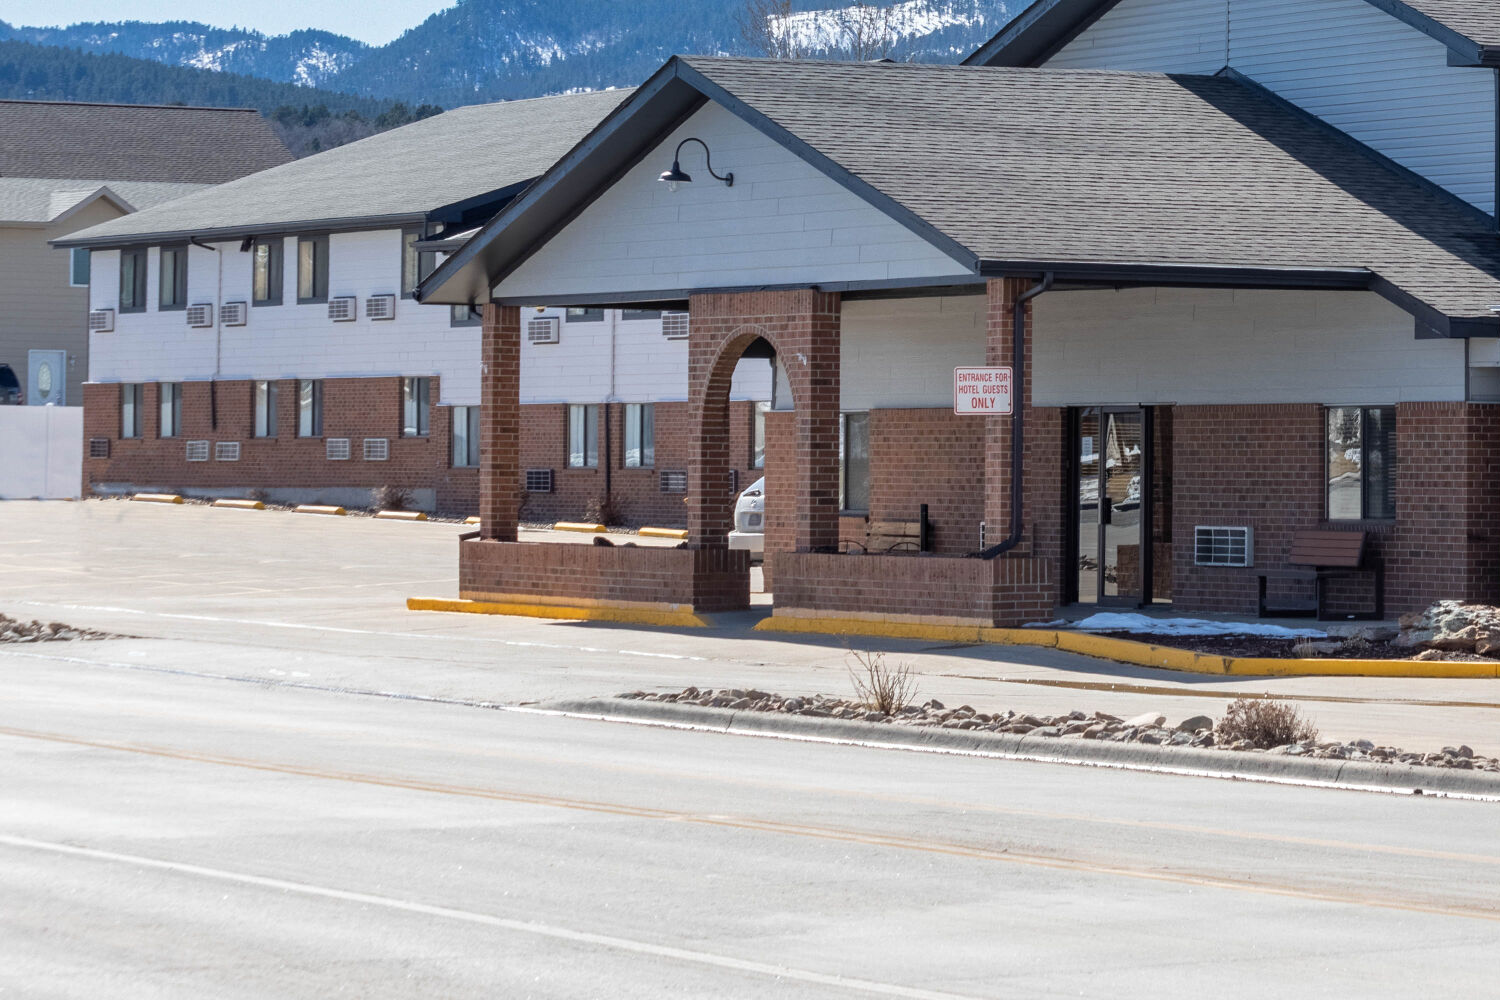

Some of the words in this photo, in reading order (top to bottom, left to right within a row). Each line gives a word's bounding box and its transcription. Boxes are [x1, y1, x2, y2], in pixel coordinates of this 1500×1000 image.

[959, 373, 992, 382] ENTRANCE
[995, 373, 1008, 382] FOR
[959, 385, 979, 394] HOTEL
[983, 385, 1008, 394] GUESTS
[971, 397, 995, 408] ONLY
